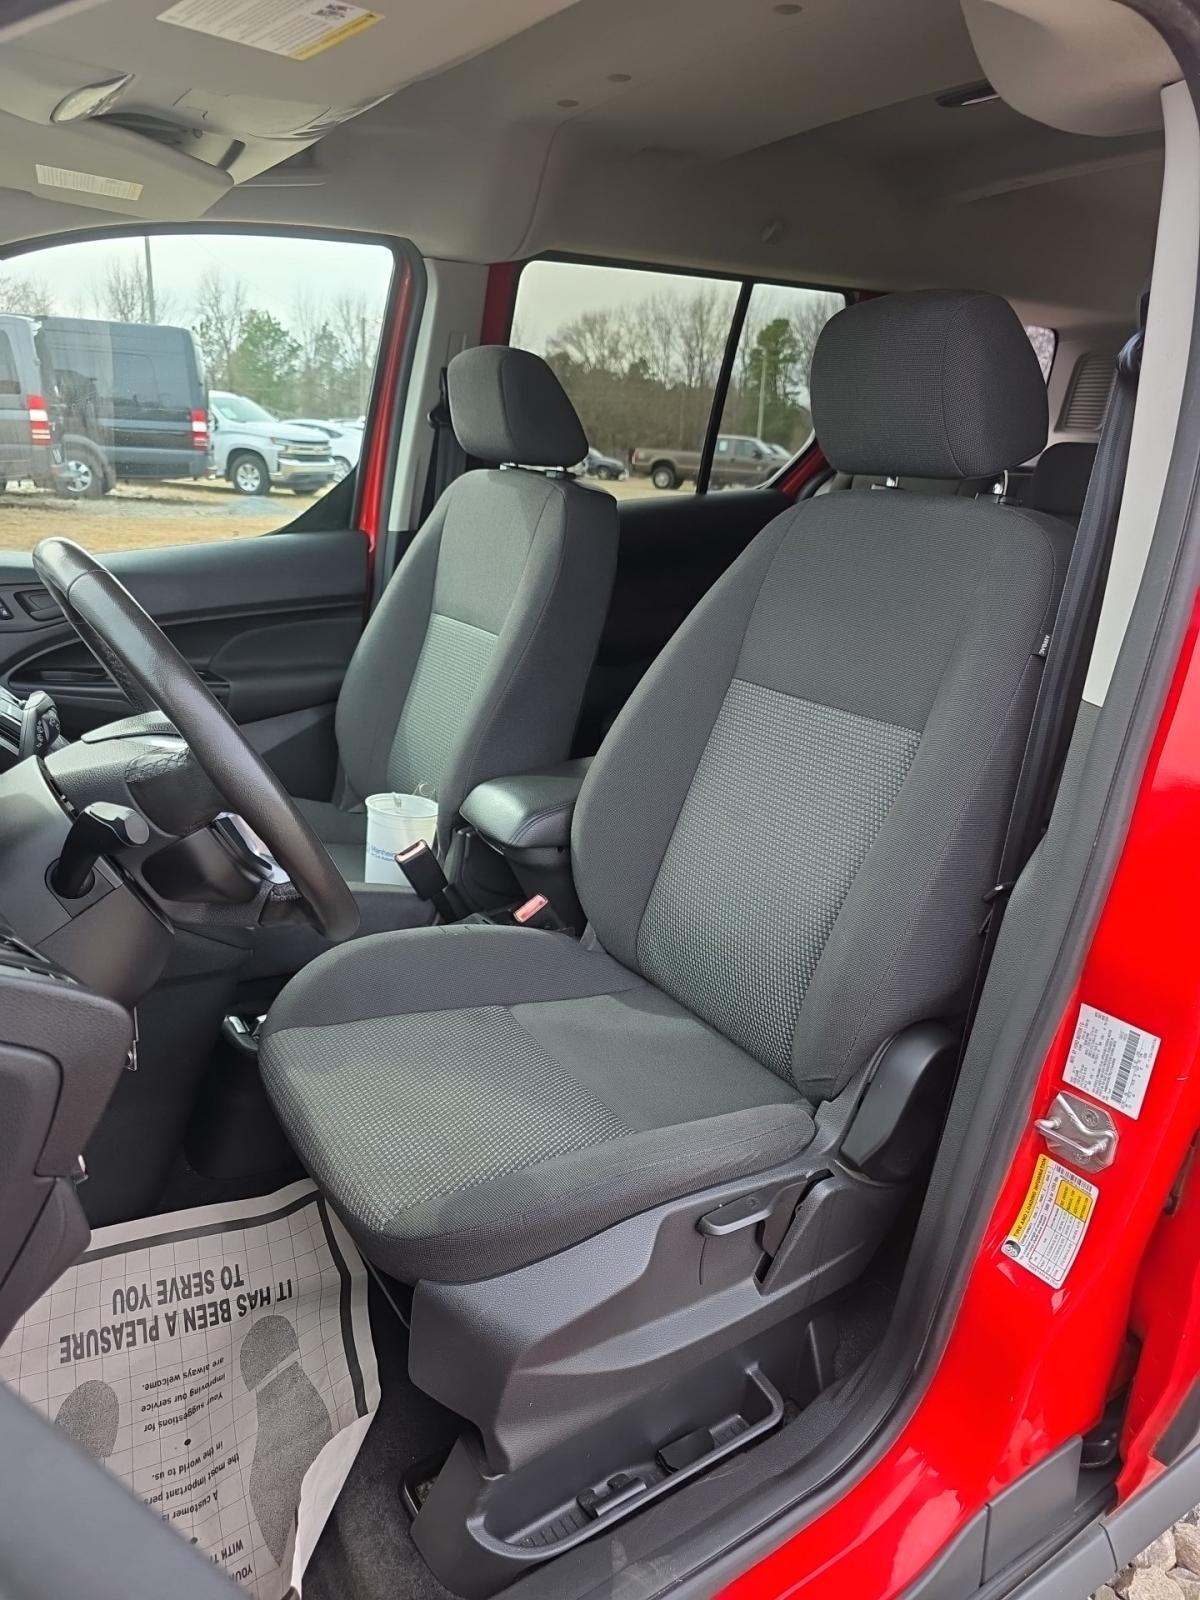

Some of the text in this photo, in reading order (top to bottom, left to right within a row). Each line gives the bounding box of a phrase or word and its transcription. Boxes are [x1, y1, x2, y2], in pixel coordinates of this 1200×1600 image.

[112, 1264, 244, 1315] TO SERVE YOU
[60, 1279, 292, 1363] IT HAS BEEN A PLEASURE
[141, 1374, 225, 1412] improving our service
[142, 1358, 224, 1391] are always welcome.
[144, 1392, 223, 1432] Your suggestions for
[144, 1453, 239, 1505] the most important pers
[152, 1441, 223, 1480] in the world to us.
[172, 1495, 210, 1520] customer
[213, 1490, 218, 1500] A
[221, 1539, 243, 1560] WITH
